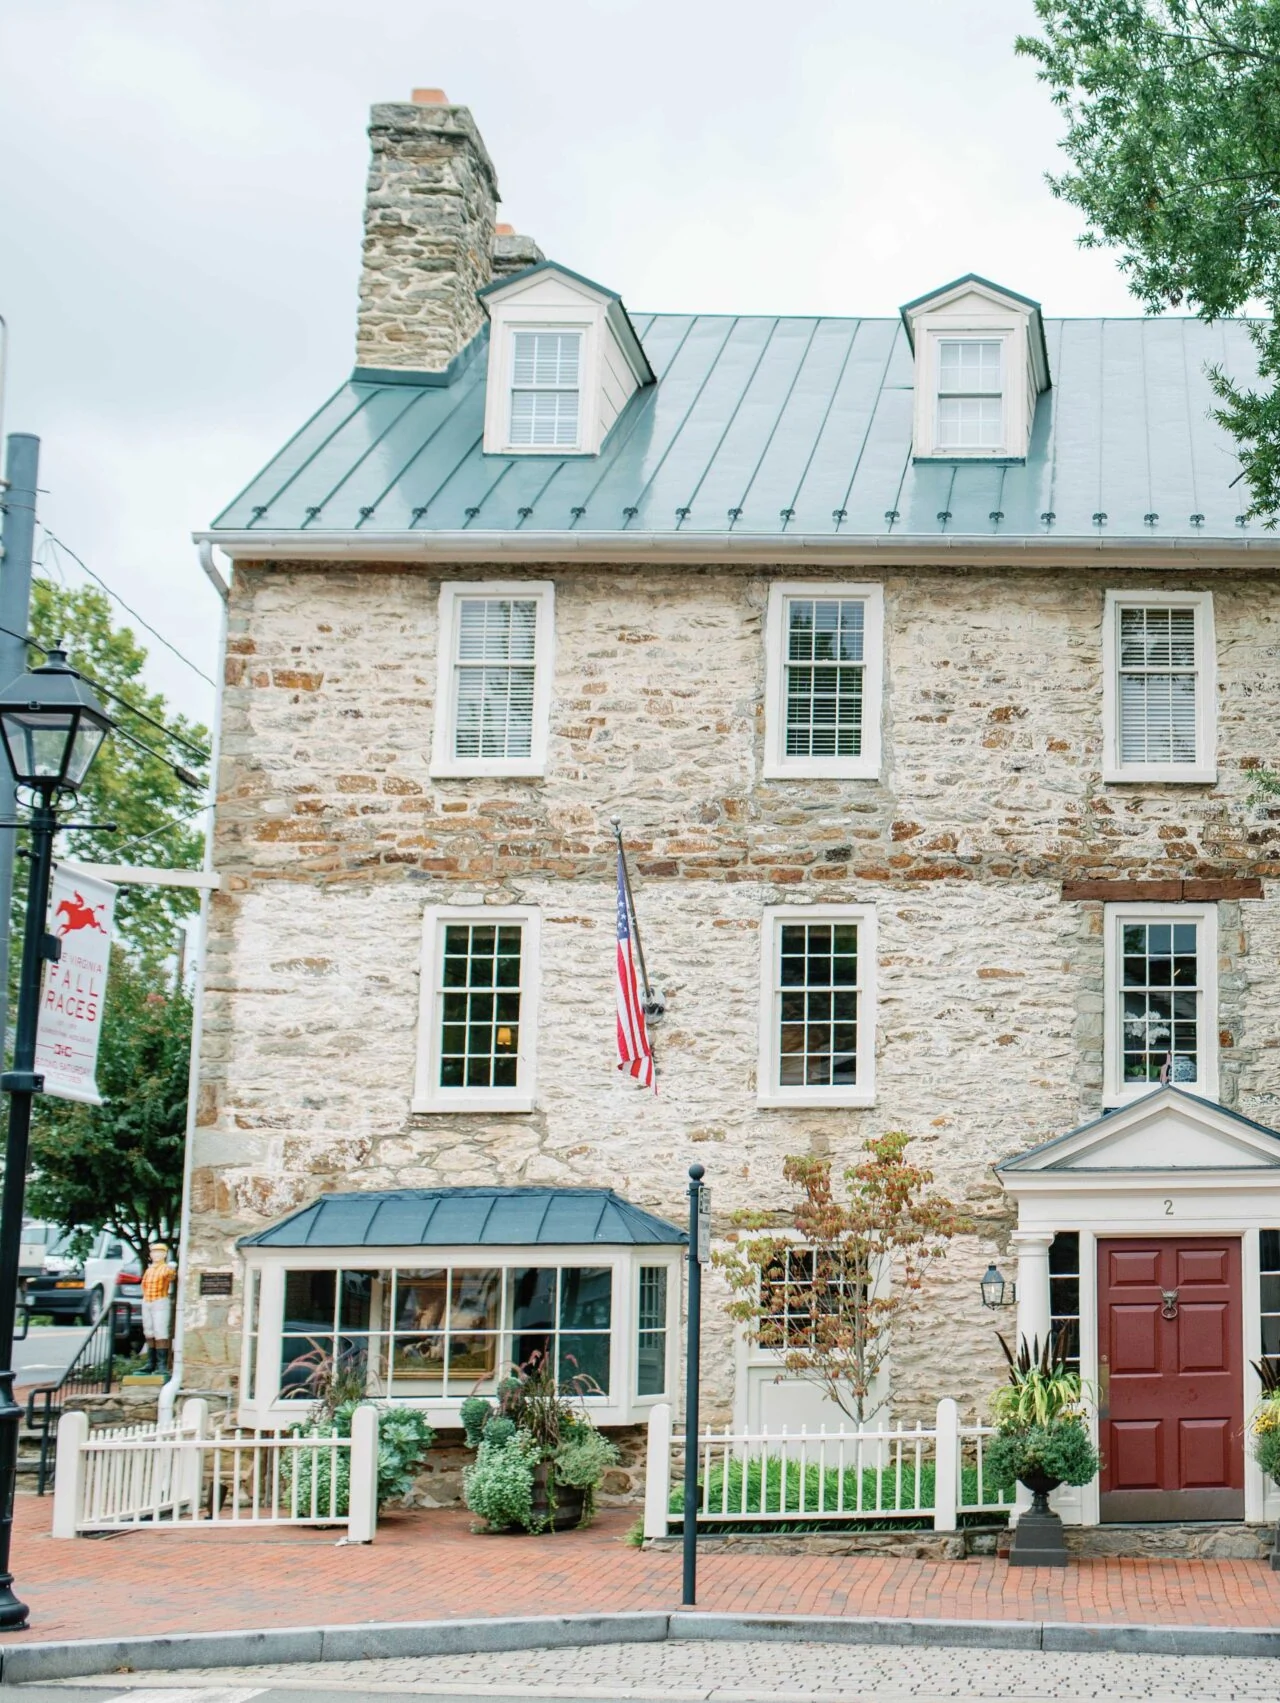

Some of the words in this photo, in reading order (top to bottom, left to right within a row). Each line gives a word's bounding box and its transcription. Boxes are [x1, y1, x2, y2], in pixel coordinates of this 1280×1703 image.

[71, 955, 102, 974] VIRGINIA
[49, 964, 98, 997] FALL
[45, 990, 96, 1021] RACES
[1163, 1199, 1174, 1216] 2
